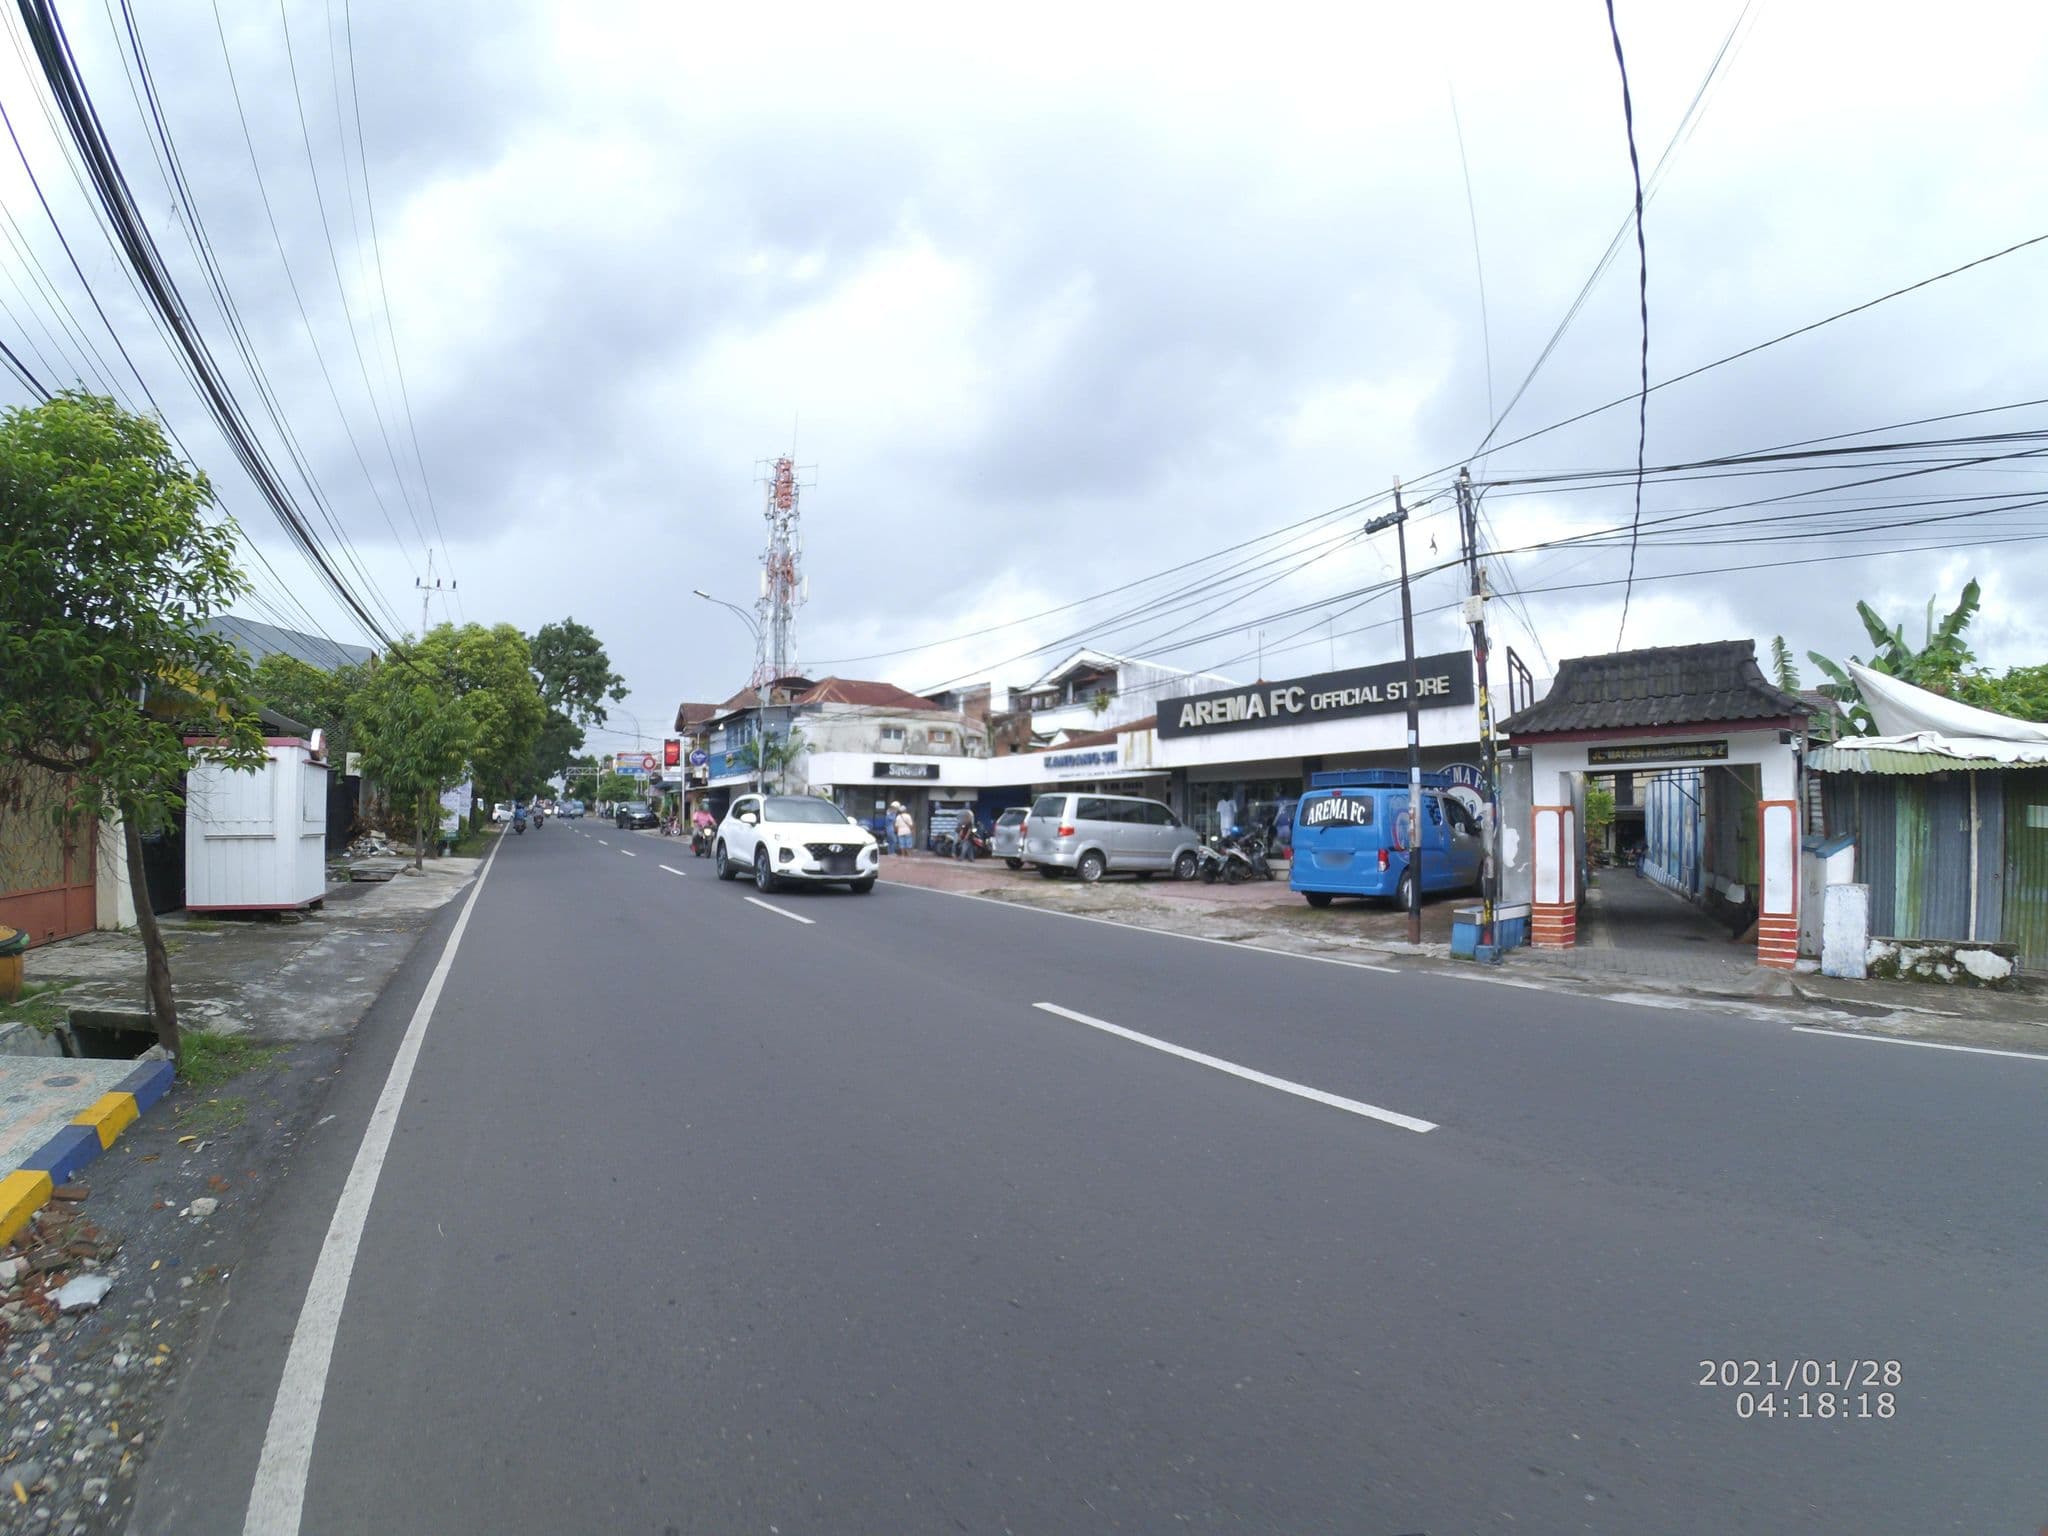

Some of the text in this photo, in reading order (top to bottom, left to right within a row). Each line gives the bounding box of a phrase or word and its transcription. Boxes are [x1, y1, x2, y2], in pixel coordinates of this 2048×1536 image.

[1179, 675, 1451, 728] AREMA FC OFFICIAL STORE
[1307, 798, 1366, 825] AREMA FC
